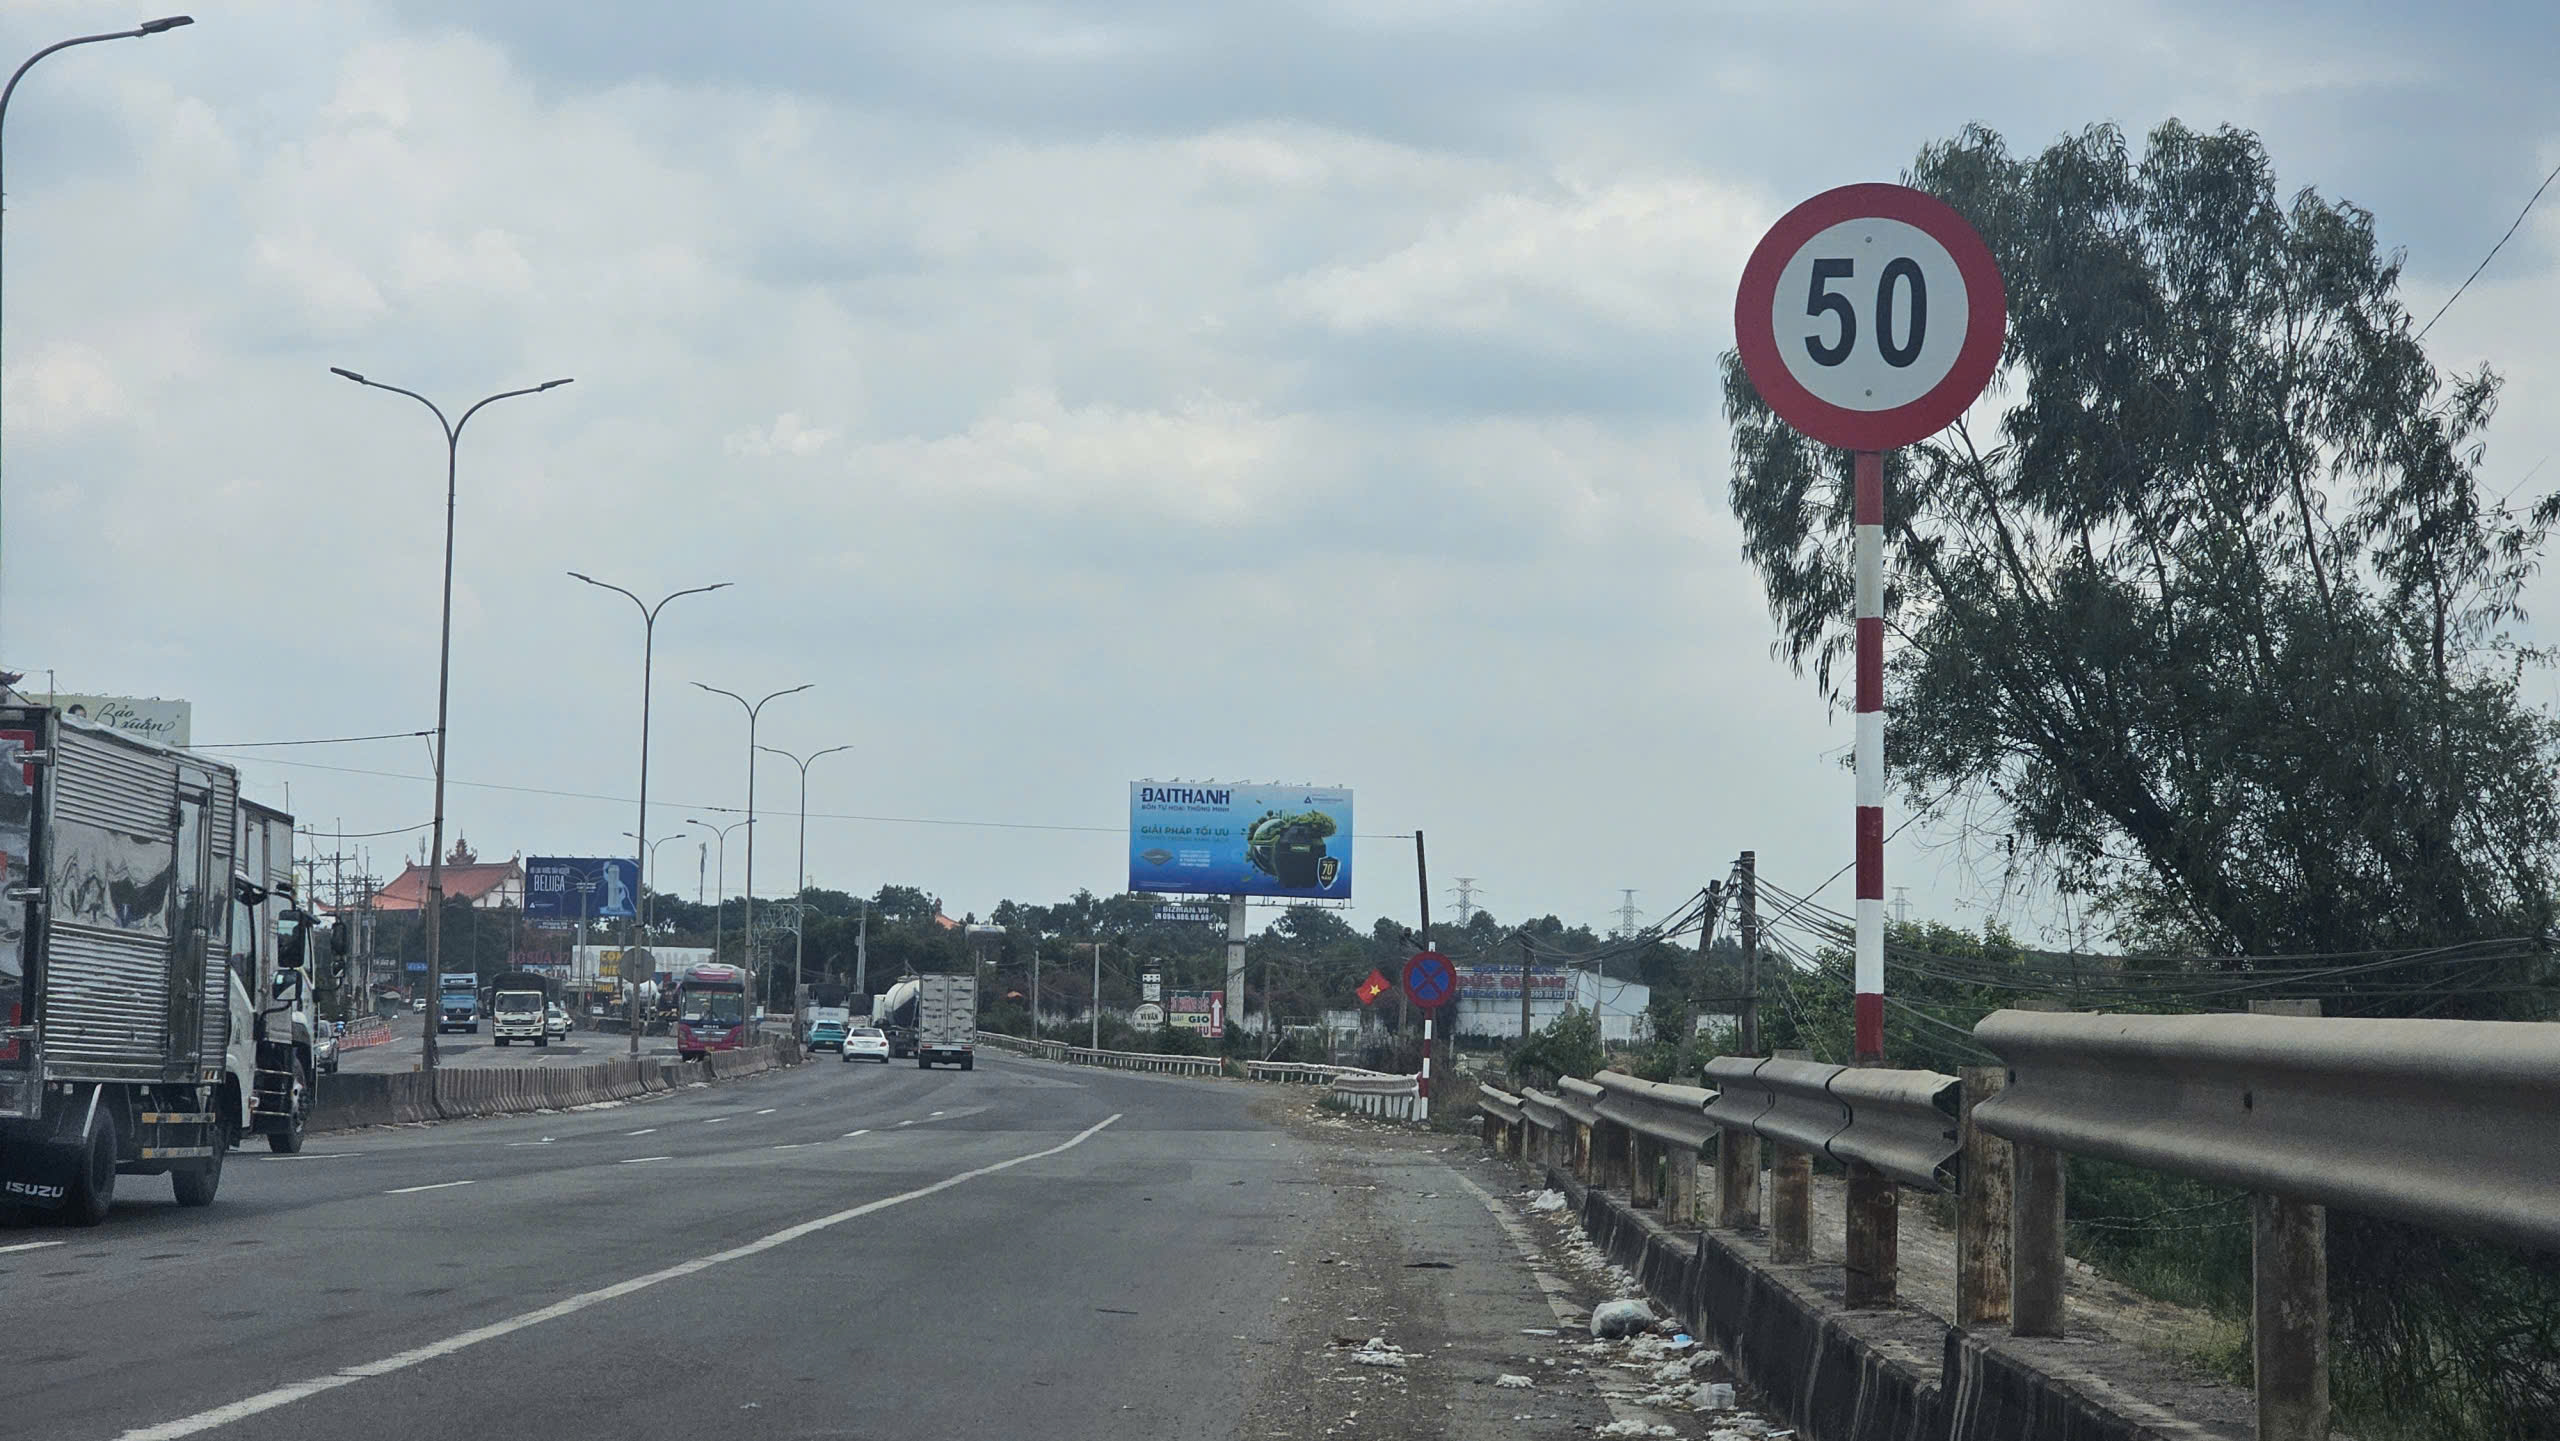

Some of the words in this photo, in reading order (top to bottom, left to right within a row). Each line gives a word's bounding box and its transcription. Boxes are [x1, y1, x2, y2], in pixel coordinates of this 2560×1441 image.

[1805, 257, 1927, 368] 50
[1322, 864, 1333, 875] 70
[534, 875, 565, 892] BELUGA
[5, 1181, 64, 1198] ISUZU
